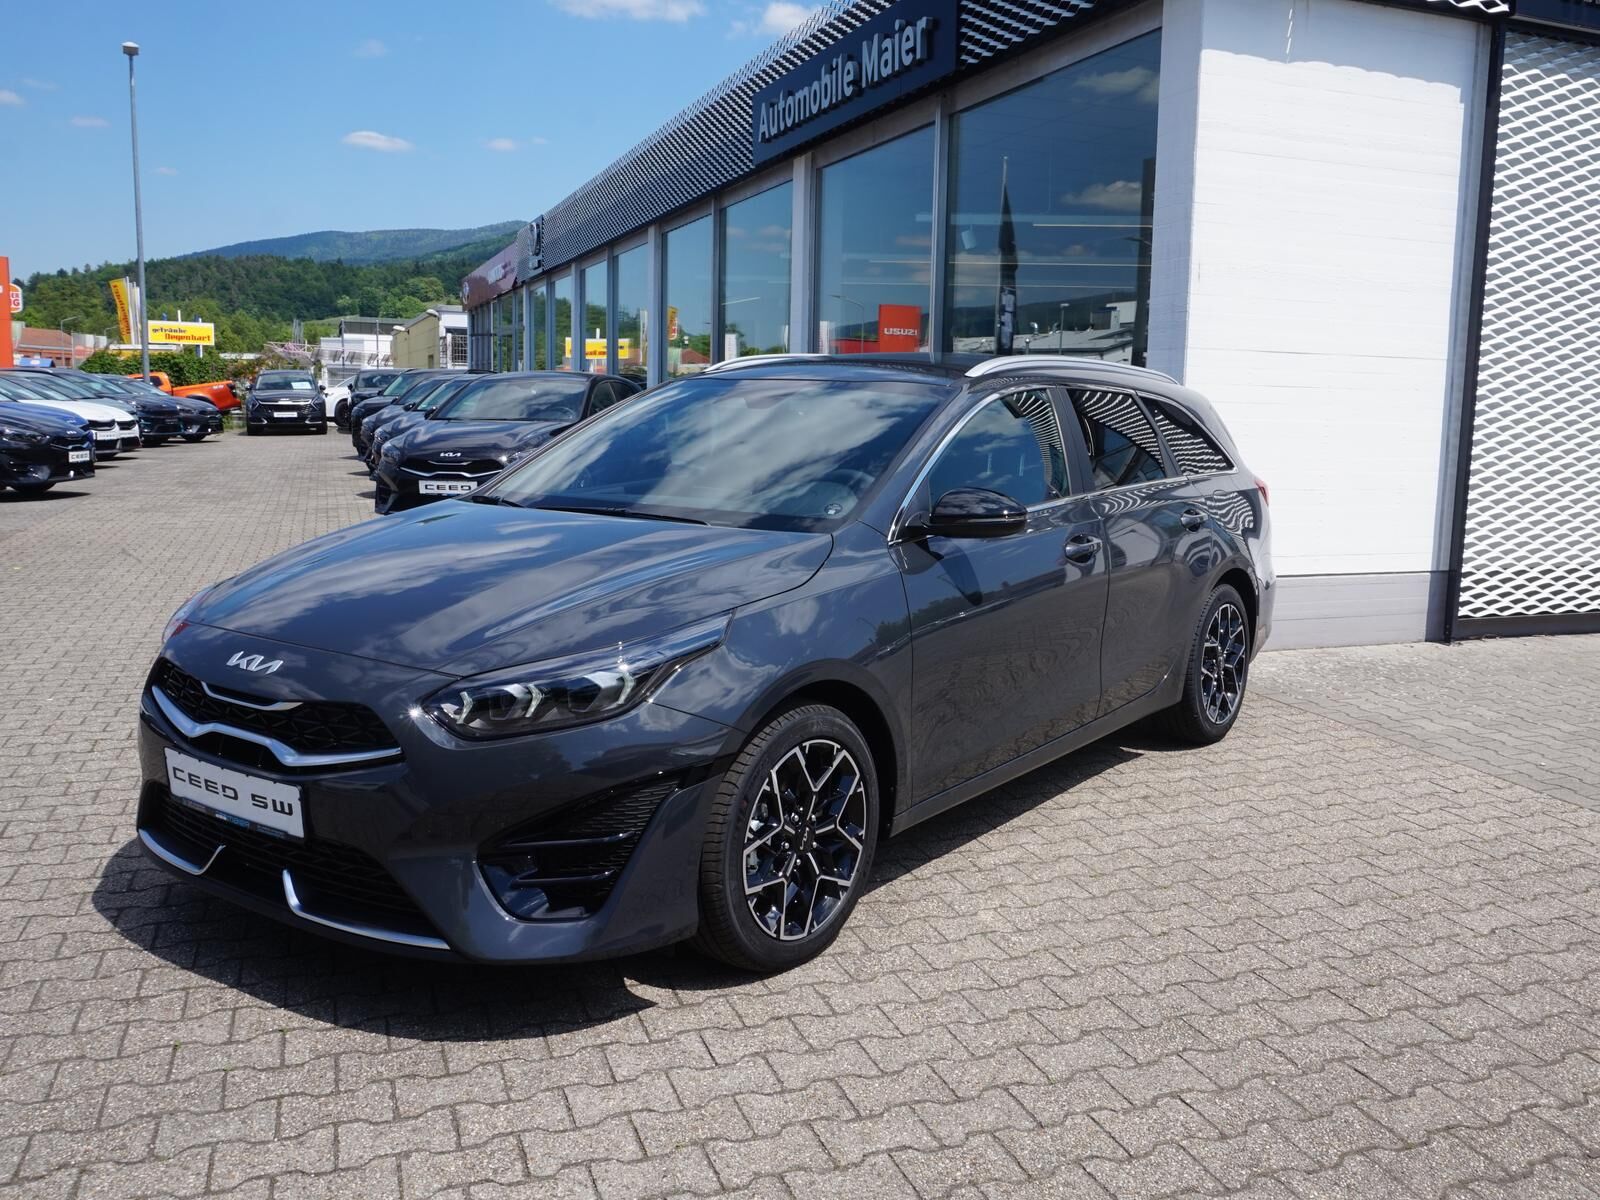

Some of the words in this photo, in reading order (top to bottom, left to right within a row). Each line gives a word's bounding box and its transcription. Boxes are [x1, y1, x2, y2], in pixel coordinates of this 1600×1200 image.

[757, 53, 857, 142] Automobile
[861, 16, 932, 88] Maier
[226, 650, 283, 675] KIA
[172, 765, 239, 801] CEED
[250, 793, 294, 817] SW
